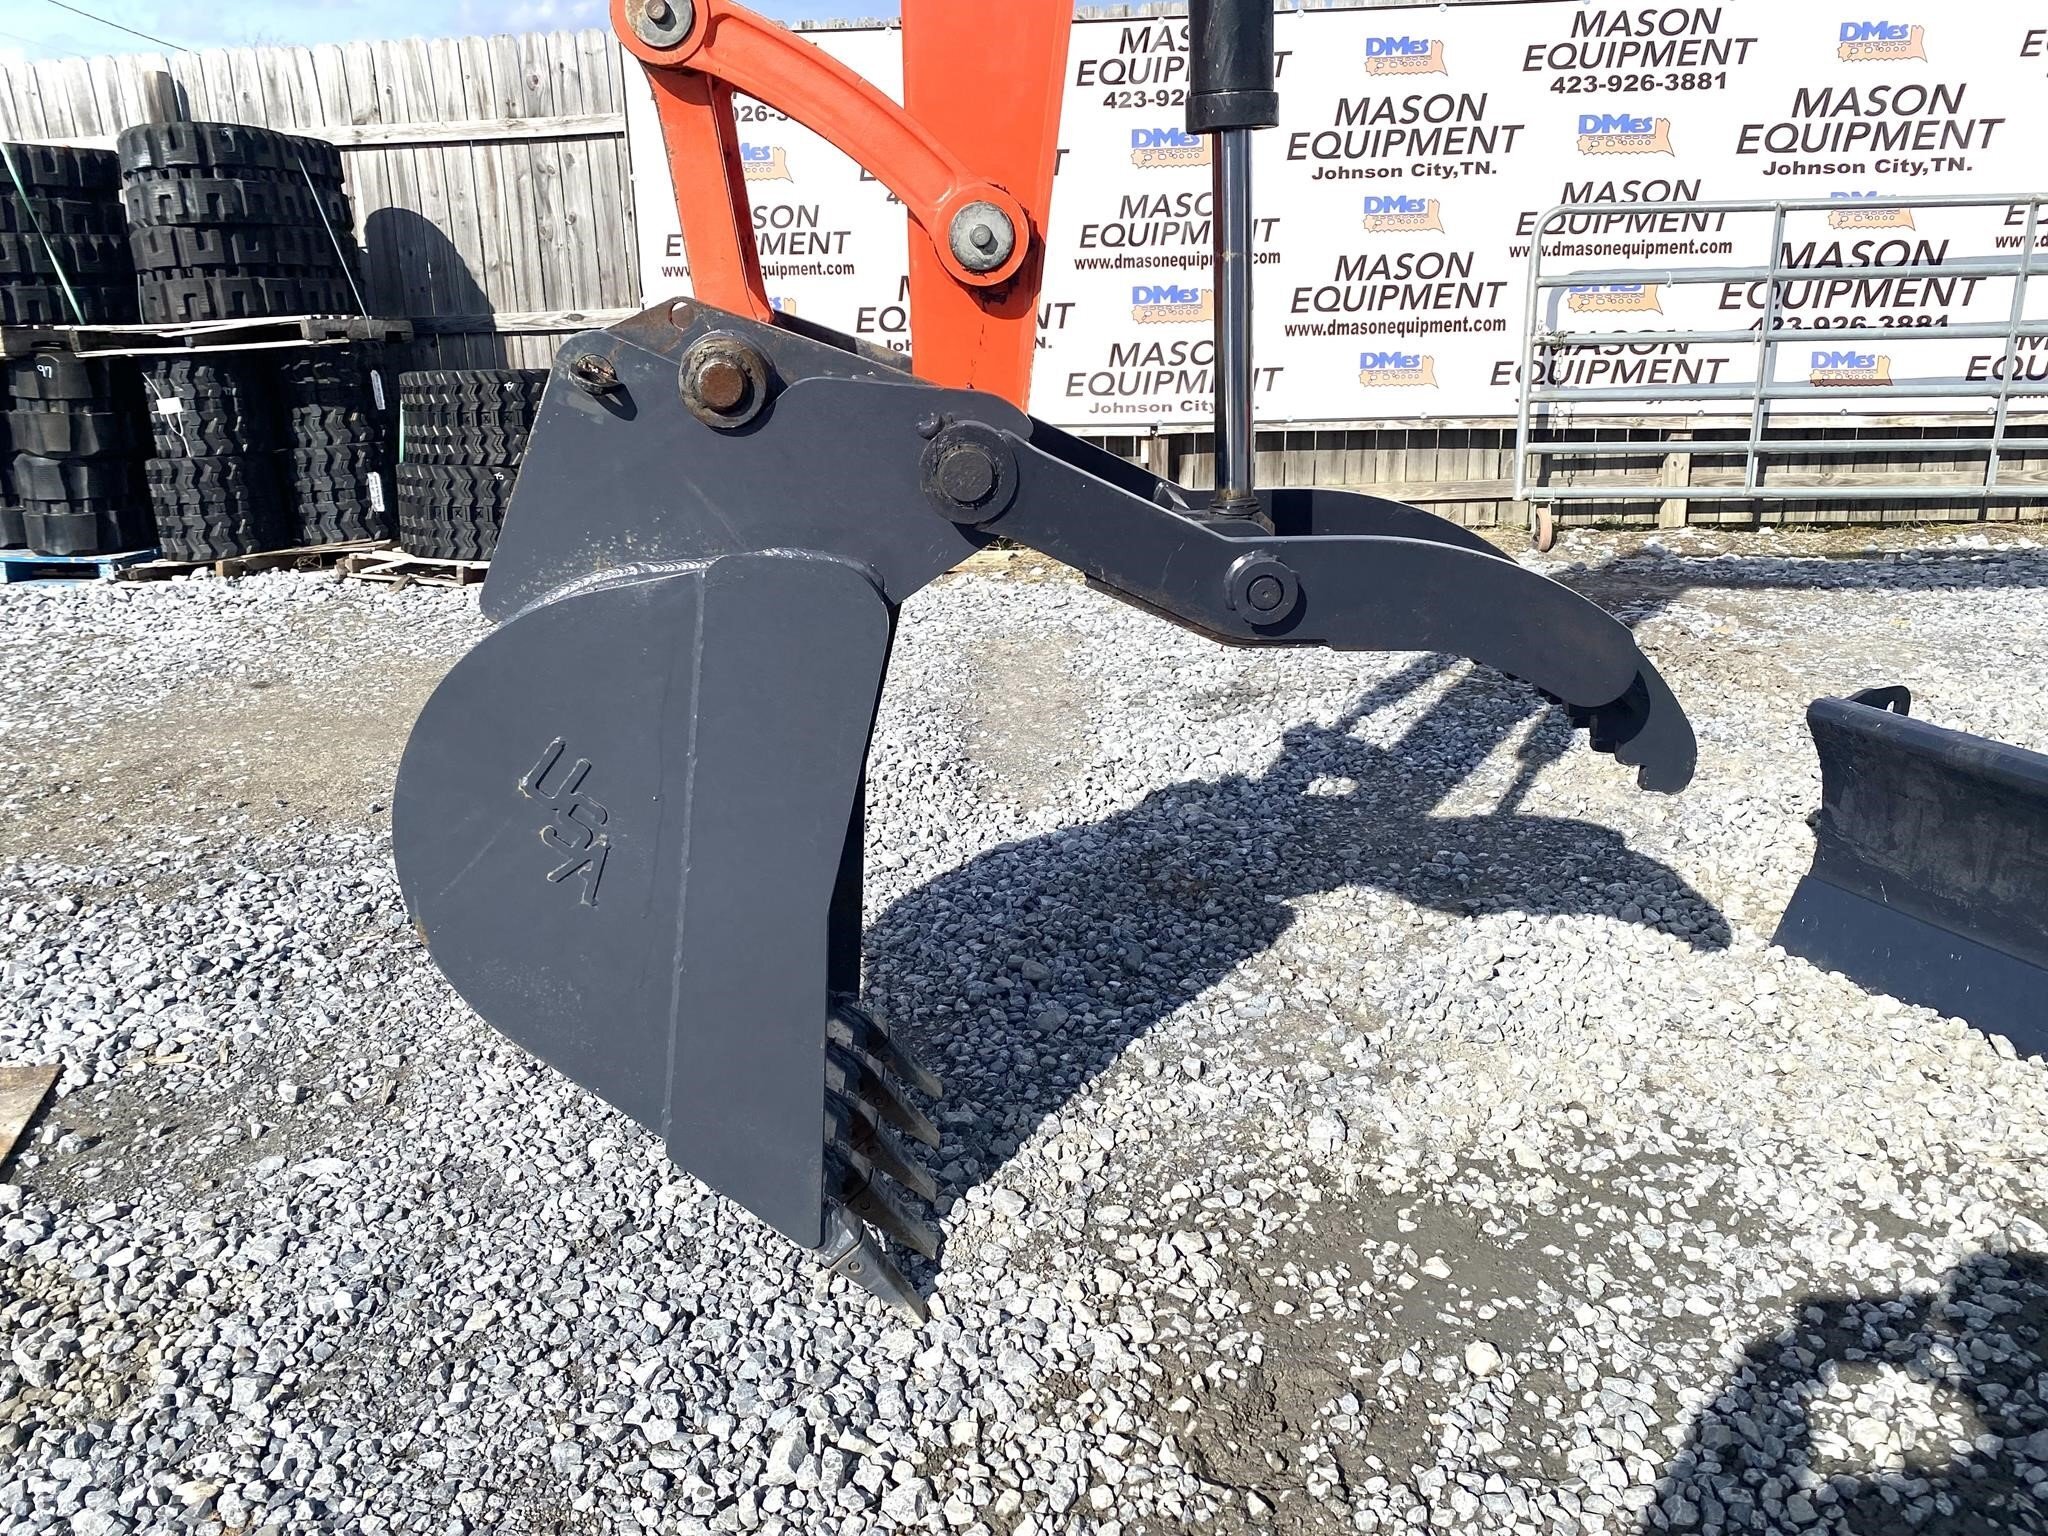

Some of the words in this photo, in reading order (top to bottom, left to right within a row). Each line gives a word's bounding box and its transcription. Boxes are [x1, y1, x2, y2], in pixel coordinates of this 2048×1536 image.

[1570, 7, 1722, 38] MASON
[1118, 25, 1189, 54] MAS
[1076, 51, 1293, 87] EQUIPT
[1522, 38, 1758, 72] EQUIPMENT
[1550, 72, 1727, 94] 423-926-3881
[1334, 93, 1488, 126] MASON
[1791, 83, 1967, 118] MASON
[1286, 125, 1525, 161] EQUIPMENT
[1736, 118, 2005, 154] EQUIPMENT
[1312, 167, 1402, 180] Johnson
[1411, 162, 1497, 179] City,TN.
[1763, 161, 1865, 176] Johnson
[1875, 157, 1973, 177] City,TN.
[1119, 192, 1212, 219] MASO
[1560, 179, 1701, 204] MASON
[752, 204, 819, 229] SON
[1516, 211, 1726, 236] EQUIPMENT
[665, 231, 851, 256] EMENT
[1080, 218, 1280, 248] EQUIPMT
[1334, 252, 1474, 281] MASON
[1780, 239, 1949, 269] MASON
[1290, 282, 1507, 313] EQUIPMENT
[1718, 277, 1986, 310] EQUIPMENT
[1284, 317, 1507, 337] www.dmasonequipment.com
[1108, 340, 1214, 367] MASO
[1065, 367, 1284, 397] EQUIPMT
[1490, 358, 1730, 386] EQUIPMENT
[1088, 402, 1173, 414] Johnson
[518, 736, 612, 907] USA
